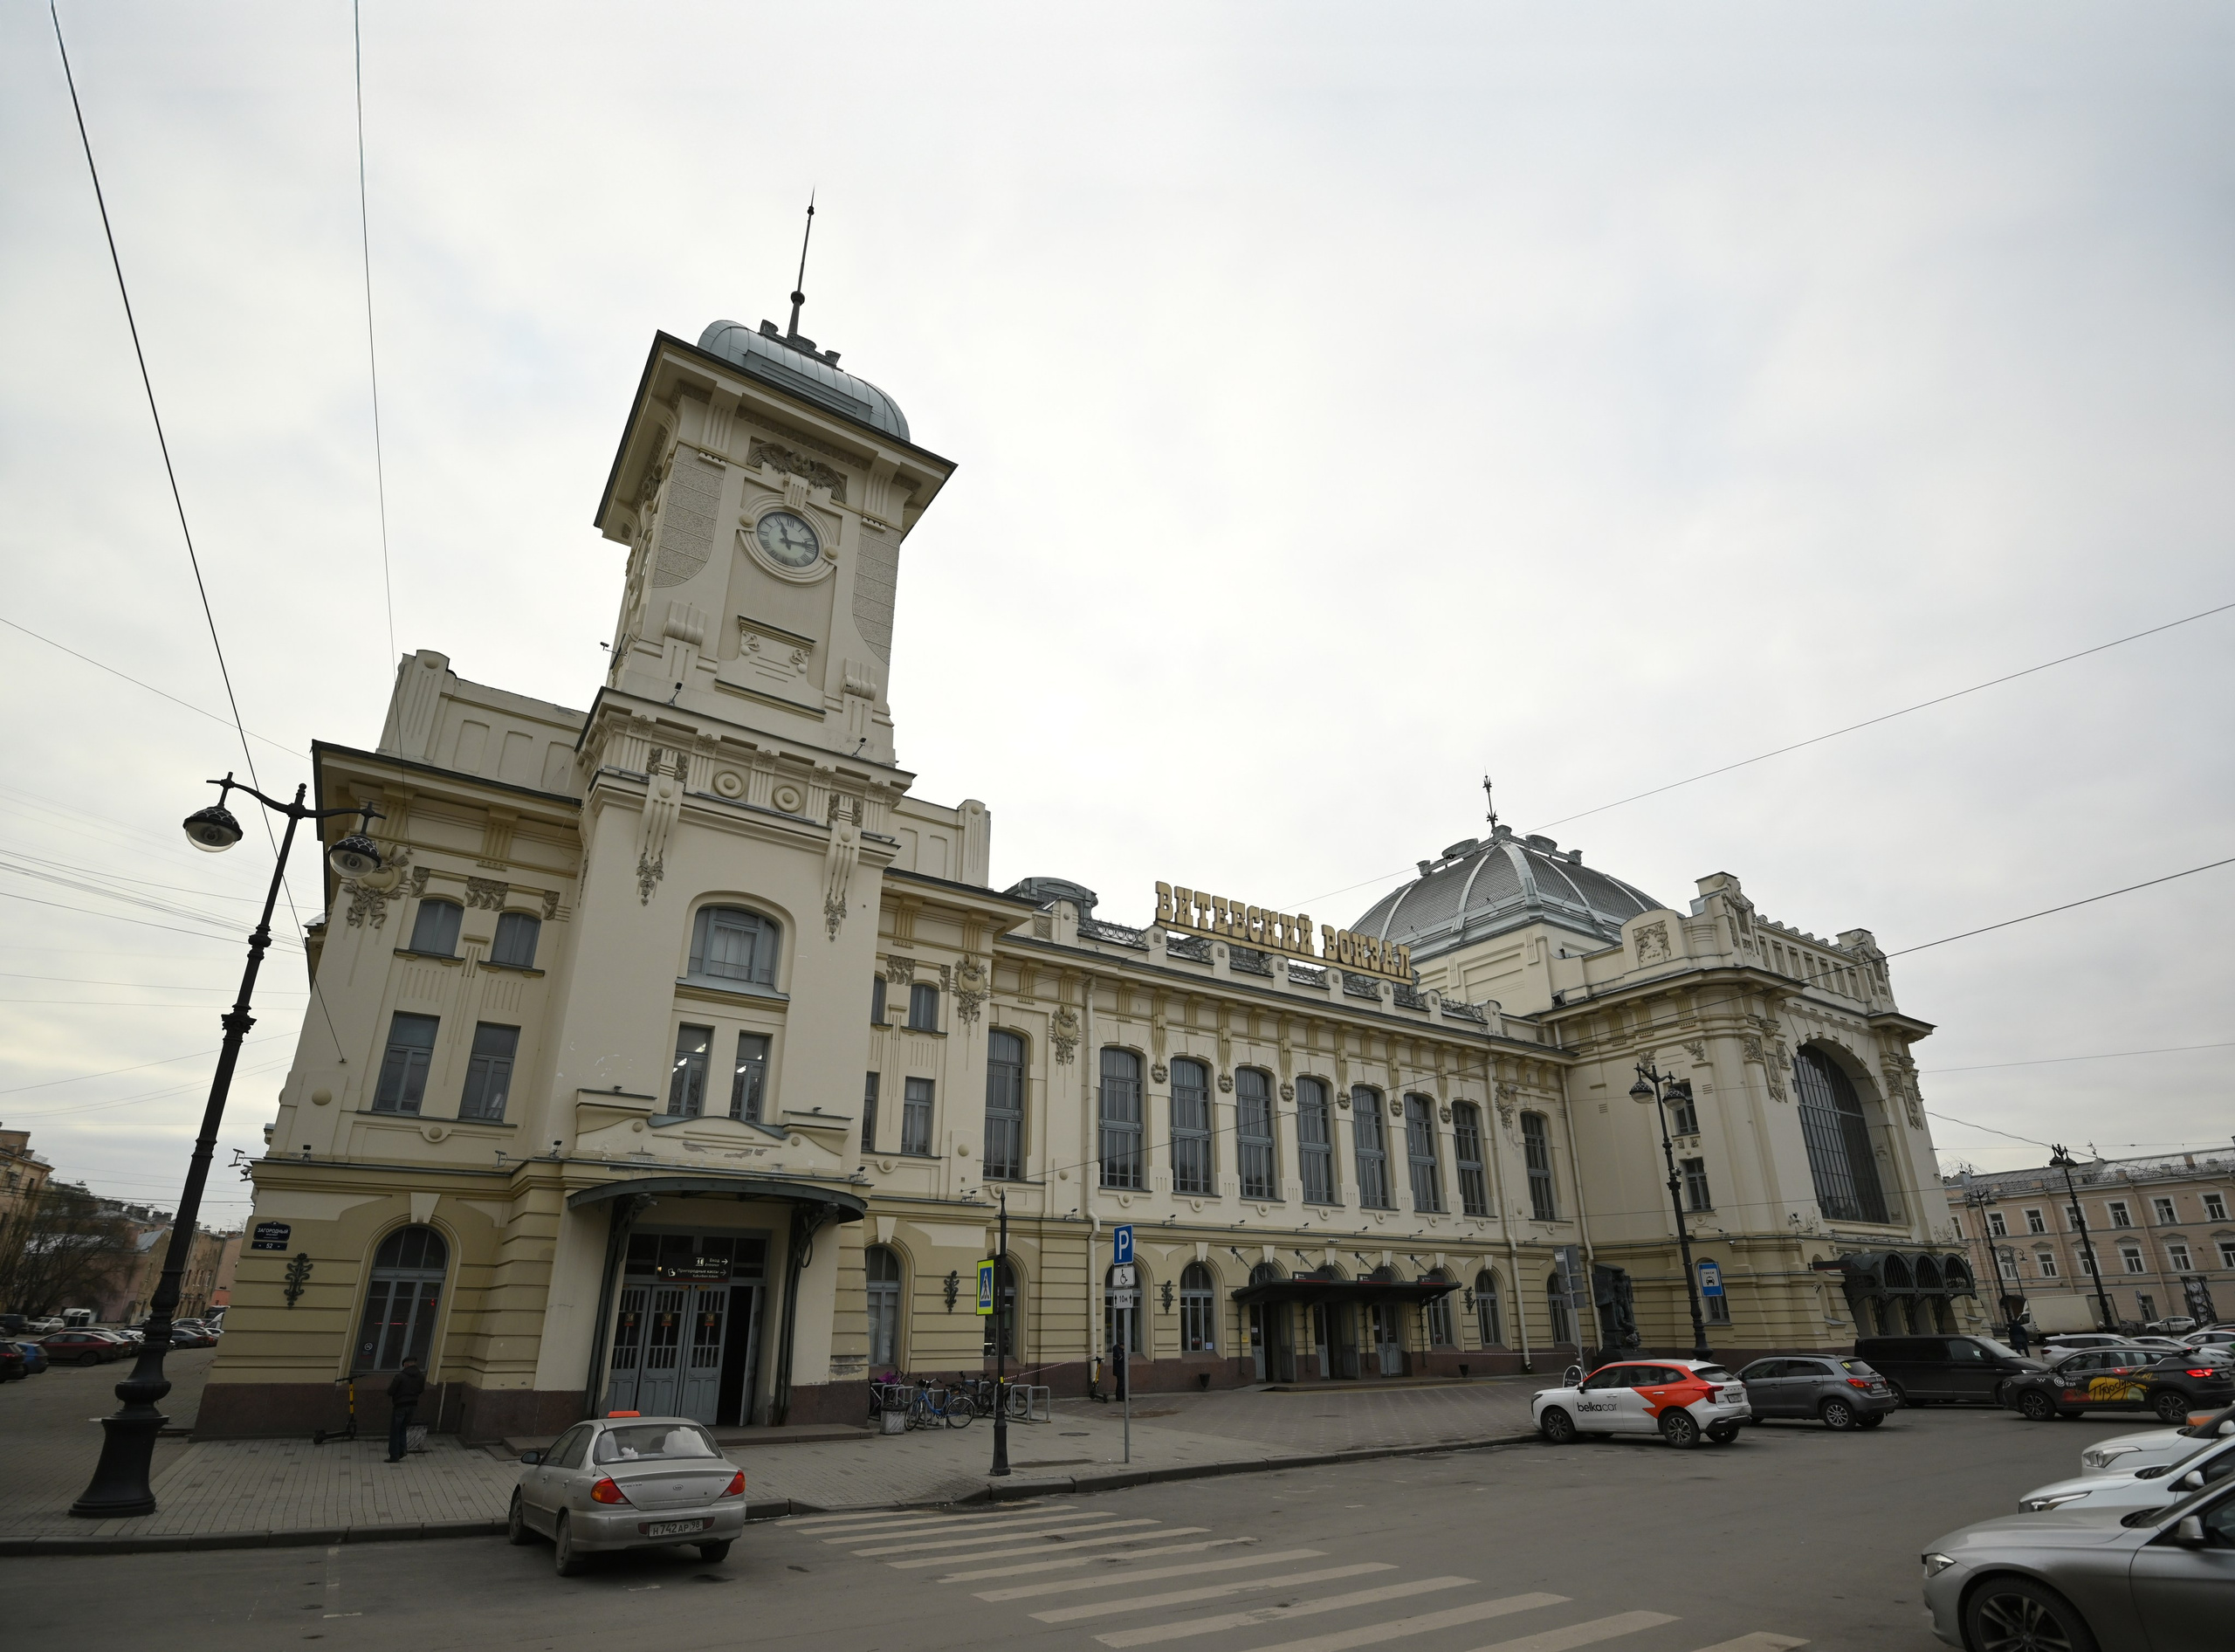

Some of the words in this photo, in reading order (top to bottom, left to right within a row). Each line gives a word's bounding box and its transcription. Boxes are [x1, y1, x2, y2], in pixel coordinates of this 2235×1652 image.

[1155, 880, 1314, 956] ВИТЕБСКИЙ
[1321, 924, 1413, 979] ВОКЗАЛ
[1577, 1402, 1617, 1412] belkacar
[691, 1520, 700, 1529] 98
